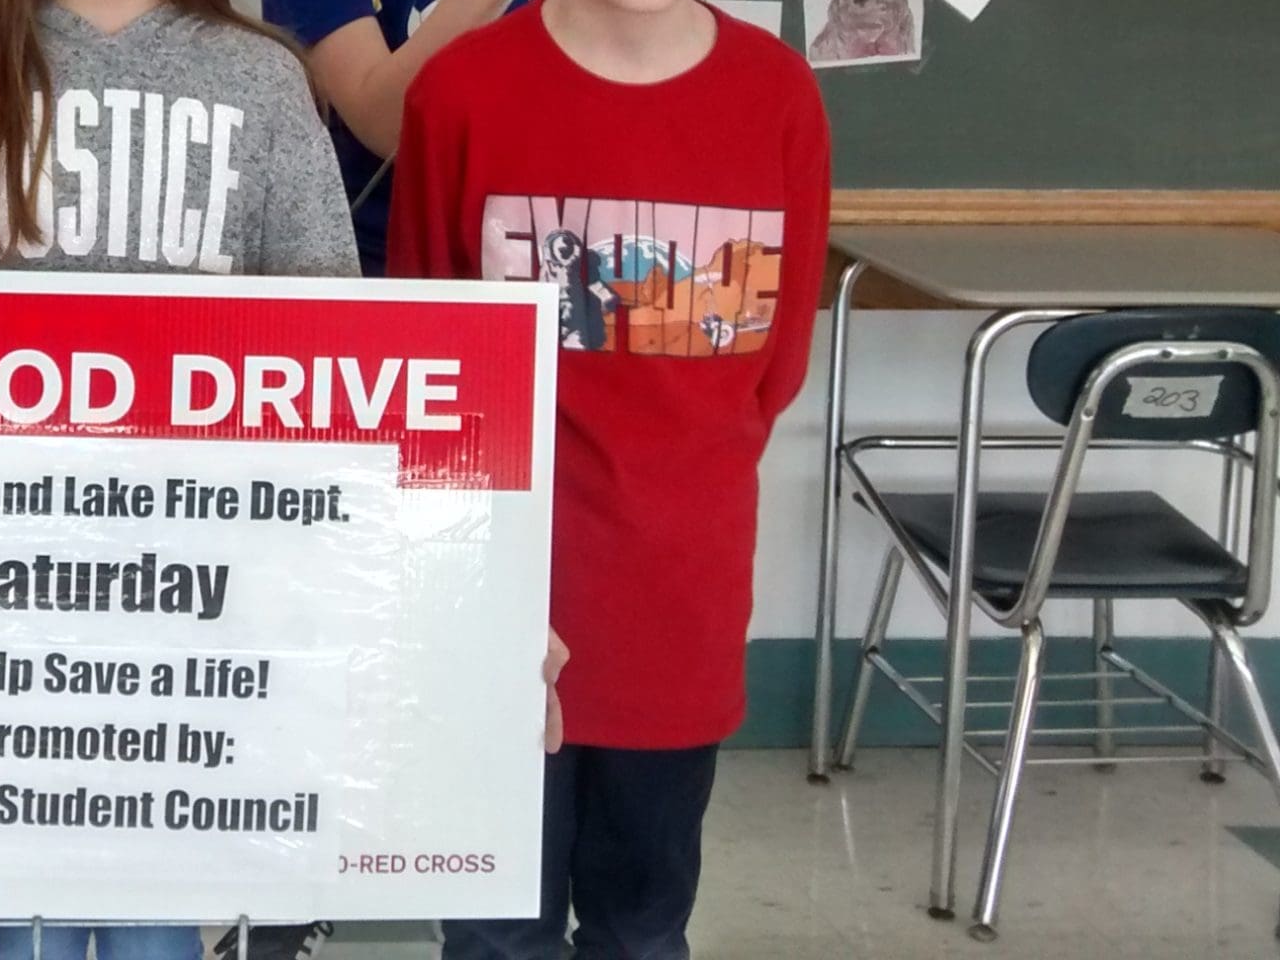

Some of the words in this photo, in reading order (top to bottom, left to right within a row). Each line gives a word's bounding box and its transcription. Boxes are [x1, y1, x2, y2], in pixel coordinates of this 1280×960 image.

[170, 354, 462, 431] DRIVE
[1142, 386, 1200, 412] 203
[63, 476, 155, 519] Lake
[165, 478, 239, 520] Fire
[250, 480, 350, 526] Dept.
[43, 652, 140, 696] Save
[150, 663, 174, 697] a
[184, 657, 270, 699] Life!
[177, 722, 235, 769] by:
[164, 789, 319, 833] Council
[414, 854, 496, 873] CROSS
